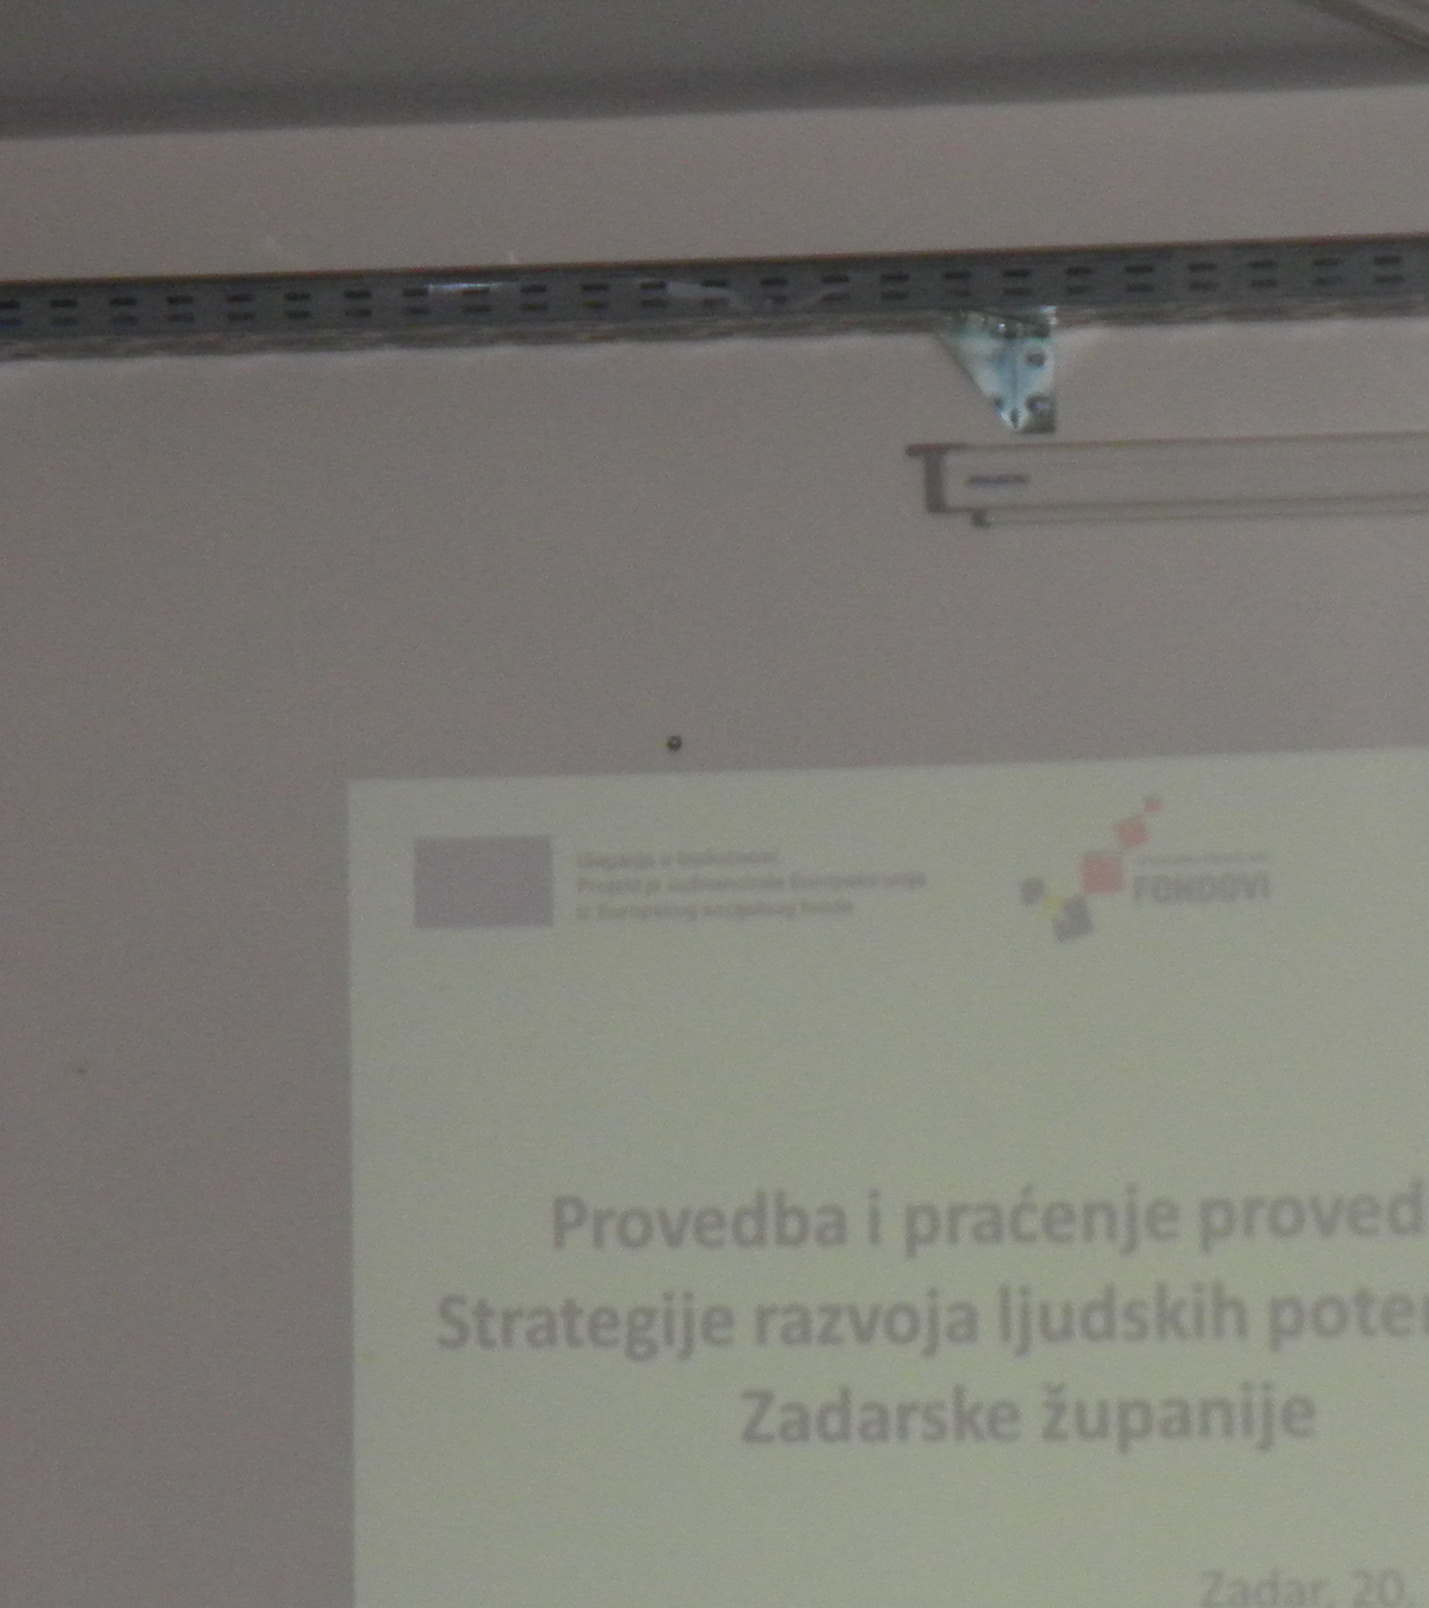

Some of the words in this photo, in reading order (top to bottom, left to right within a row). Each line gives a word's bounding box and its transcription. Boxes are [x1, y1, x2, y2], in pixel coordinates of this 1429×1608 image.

[549, 1188, 848, 1252] Provedba
[867, 1188, 882, 1247] i
[902, 1183, 1181, 1261] praćenje
[434, 1290, 736, 1364] Strategije
[753, 1286, 980, 1359] razvoja
[998, 1280, 1249, 1359] ljudskih
[739, 1383, 1022, 1447] Zadarske
[1040, 1380, 1317, 1456] županije
